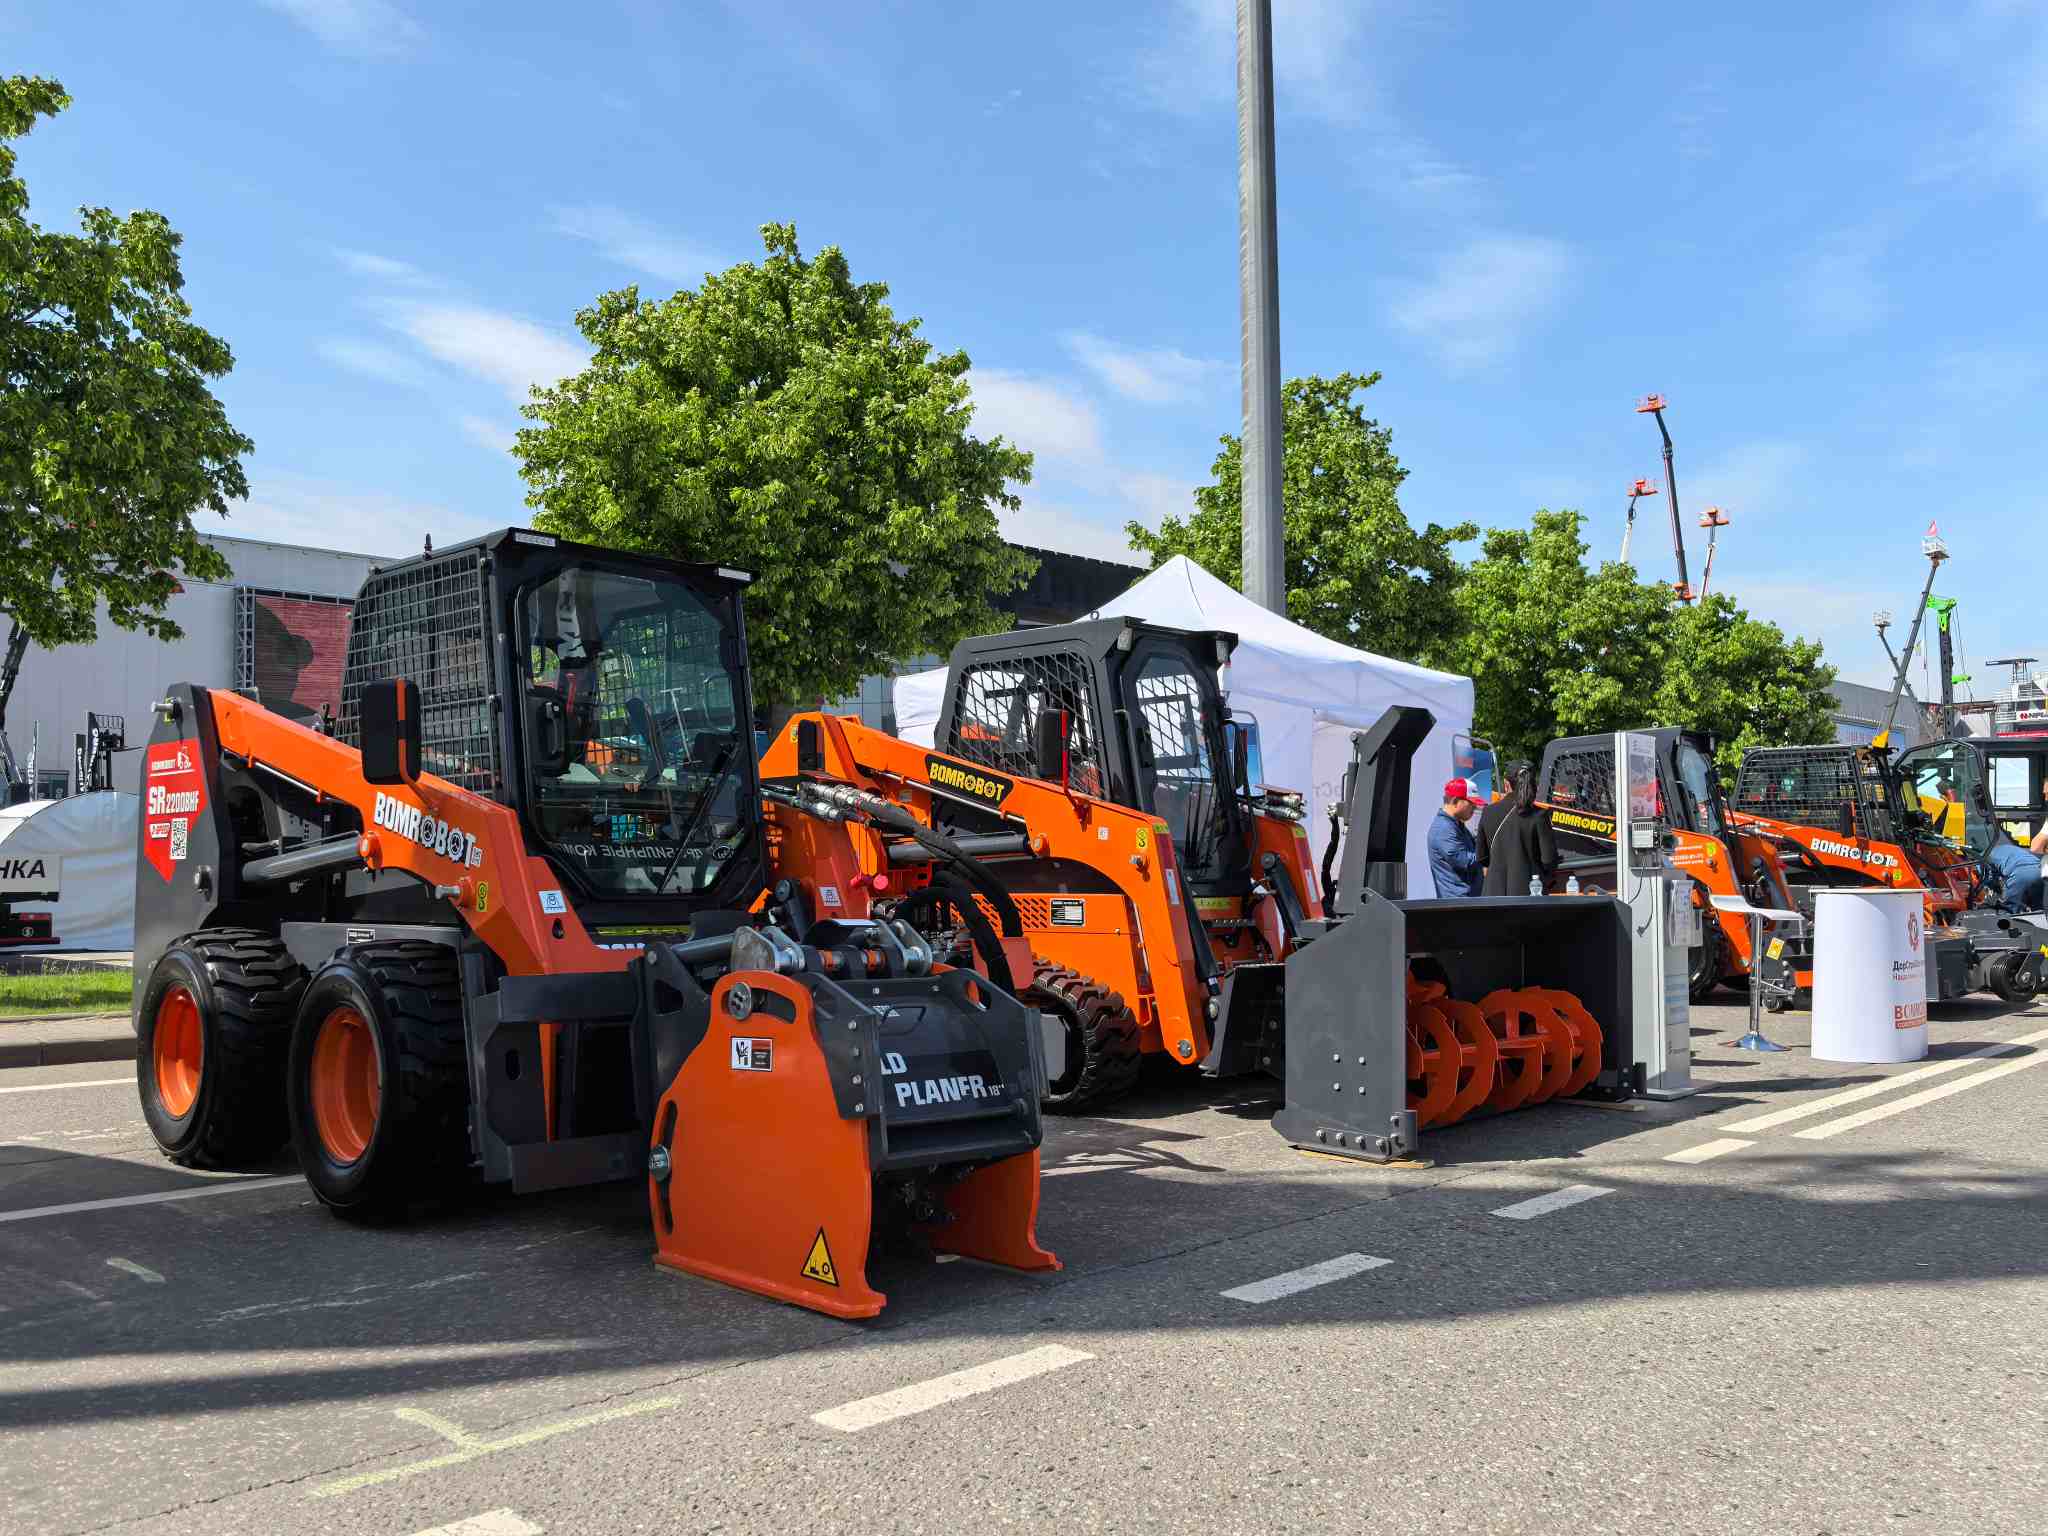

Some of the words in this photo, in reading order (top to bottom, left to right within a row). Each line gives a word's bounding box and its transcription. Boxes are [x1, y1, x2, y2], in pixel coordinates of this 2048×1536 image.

[929, 762, 1004, 801] BOMROBOT
[374, 791, 477, 869] BOMROBOT
[1551, 810, 1615, 834] BOMROBOT
[894, 1074, 988, 1108] PLANER
